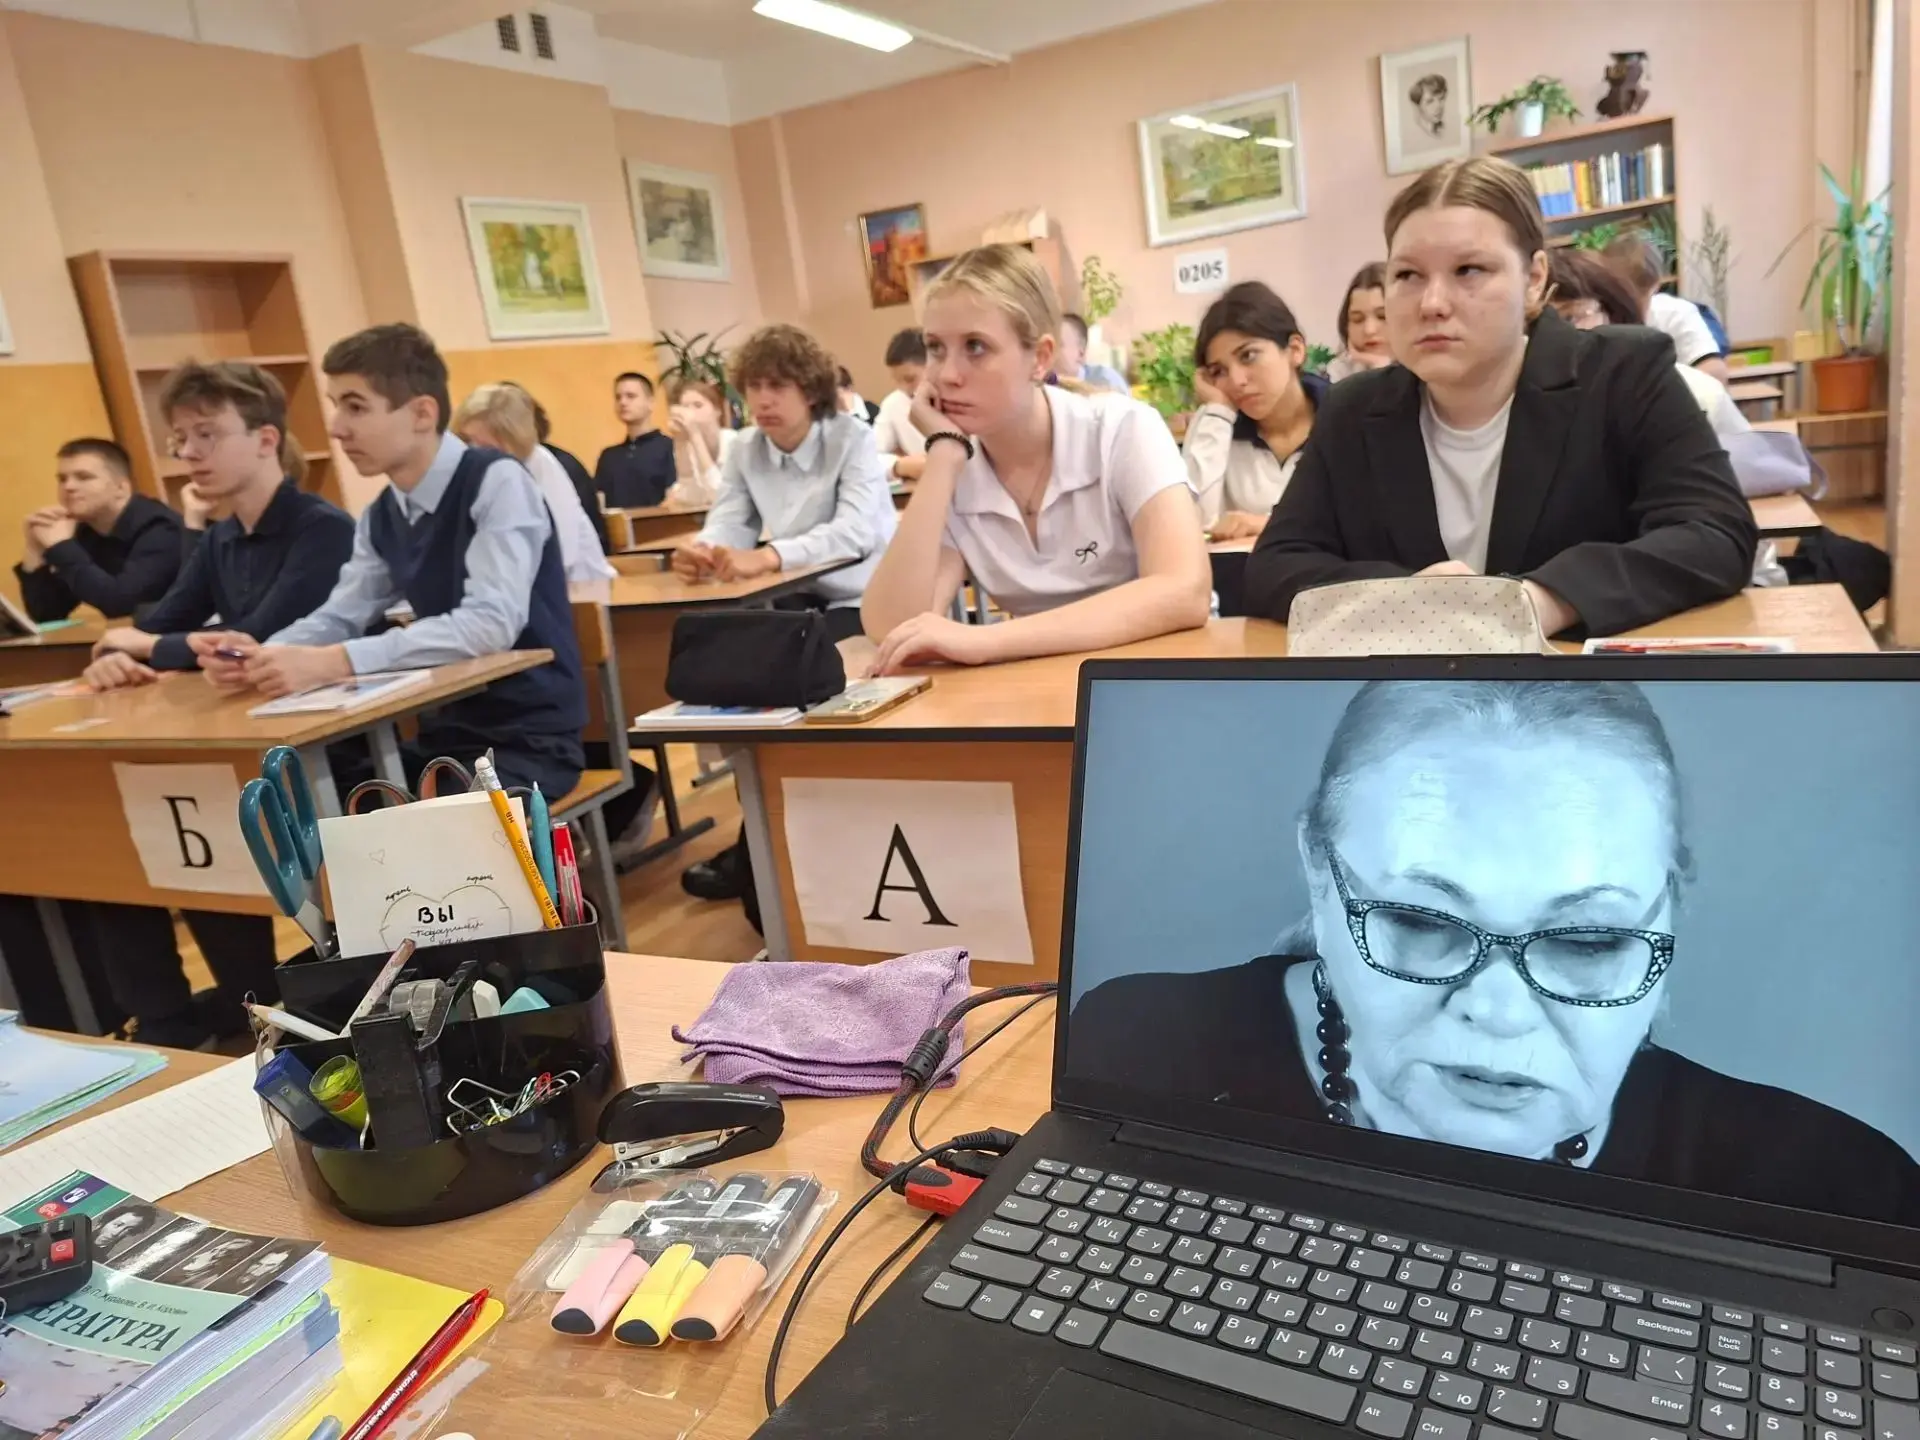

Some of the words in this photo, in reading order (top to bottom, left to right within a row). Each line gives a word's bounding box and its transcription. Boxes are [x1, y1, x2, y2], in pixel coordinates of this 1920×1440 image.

[1179, 260, 1223, 283] 0205
[163, 795, 214, 868] Б
[863, 823, 959, 926] А
[1004, 1201, 1018, 1209] Tab
[1057, 1209, 1069, 1218] Q
[1128, 1207, 1138, 1215] 3
[1068, 1221, 1079, 1230] Й
[1097, 1218, 1112, 1228] W
[1170, 1217, 1179, 1225] 4
[982, 1226, 1012, 1238] CapsLk
[1107, 1229, 1119, 1239] Ц
[1136, 1228, 1149, 1237] E
[1211, 1226, 1222, 1235] 5
[1047, 1237, 1058, 1247] A
[1152, 1241, 1161, 1250] У
[1178, 1238, 1192, 1248] R
[1256, 1237, 1267, 1245] 6
[1308, 1238, 1317, 1247] &
[1088, 1247, 1100, 1257] S
[1302, 1248, 1314, 1256] 7
[1332, 1243, 1341, 1251] ?
[959, 1251, 979, 1261] Shift
[1060, 1251, 1069, 1259] Ф
[1193, 1252, 1204, 1261] К
[1225, 1248, 1236, 1258] T
[1099, 1261, 1112, 1270] Ы
[1129, 1257, 1142, 1267] D
[1271, 1259, 1283, 1270] Y
[1350, 1259, 1361, 1269] 8
[1173, 1268, 1187, 1278] F
[1239, 1263, 1250, 1273] Е
[1047, 1270, 1061, 1280] Z
[1143, 1272, 1155, 1281] В
[1285, 1275, 1298, 1285] Н
[1316, 1271, 1330, 1282] U
[1399, 1271, 1410, 1280] 9
[934, 1281, 949, 1291] Ctrl
[1060, 1285, 1072, 1294] Я
[1090, 1280, 1104, 1291] X
[1190, 1284, 1200, 1294] А
[1219, 1280, 1233, 1291] G
[1451, 1283, 1462, 1292] 0
[1335, 1287, 1347, 1296] Г
[979, 1294, 992, 1303] Fn
[1105, 1296, 1116, 1306] Ч
[1134, 1293, 1148, 1303] C
[1235, 1296, 1248, 1306] П
[1265, 1292, 1281, 1304] H
[1417, 1296, 1432, 1308] O
[1662, 1297, 1692, 1309] Delete
[1182, 1304, 1194, 1315] V
[1383, 1300, 1397, 1310] Ш
[1149, 1309, 1160, 1318] С
[1284, 1309, 1296, 1319] Р
[1316, 1306, 1328, 1316] J
[1469, 1308, 1483, 1318] P
[1434, 1310, 1449, 1323] Щ
[24, 1299, 182, 1351] ЕРАТУРА
[1064, 1319, 1079, 1328] Alt
[1193, 1321, 1208, 1332] М
[1226, 1317, 1240, 1329] B
[1366, 1318, 1381, 1330] K
[1636, 1317, 1693, 1337] Backspace
[1244, 1334, 1257, 1345] И
[1275, 1331, 1291, 1343] N
[1386, 1336, 1399, 1347] Л
[1419, 1332, 1429, 1344] L
[1718, 1335, 1741, 1345] Num
[1549, 1339, 1561, 1350] Х
[1718, 1342, 1740, 1351] Lock
[1297, 1349, 1307, 1359] Т
[1327, 1345, 1346, 1358] M
[1441, 1351, 1453, 1361] Д
[1607, 1352, 1620, 1364] Ъ
[1348, 1364, 1360, 1375] Ь
[1493, 1363, 1511, 1375] Ж
[1714, 1364, 1727, 1376] 7
[1402, 1379, 1416, 1390] Б
[1557, 1380, 1570, 1390] Э
[1718, 1381, 1743, 1392] Home
[1768, 1378, 1781, 1390] 8
[1456, 1393, 1472, 1405] Ю
[1496, 1389, 1506, 1399] ?
[1825, 1391, 1838, 1403] 9
[1651, 1396, 1684, 1410] Enter
[1364, 1406, 1381, 1417] Alt
[1709, 1404, 1723, 1416] 4
[1832, 1407, 1857, 1420] PgUp
[1766, 1416, 1780, 1430] 5
[1421, 1422, 1444, 1435] Ctrl
